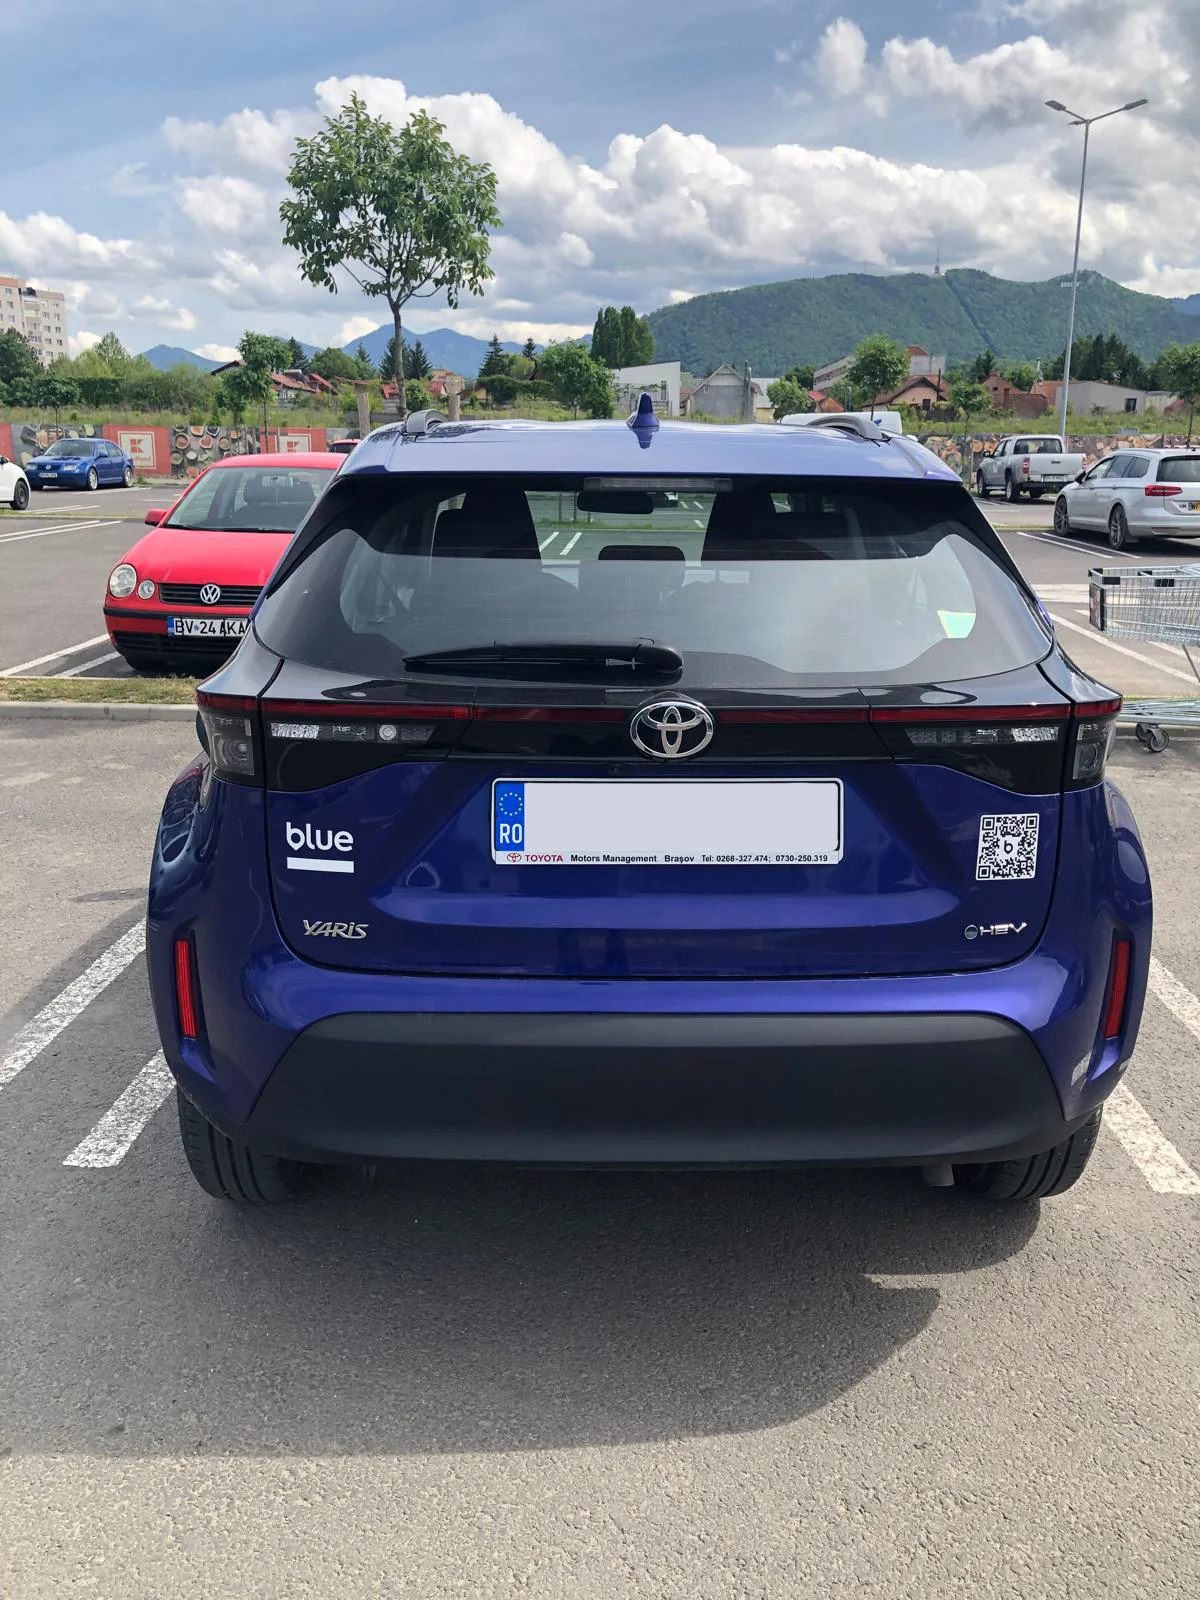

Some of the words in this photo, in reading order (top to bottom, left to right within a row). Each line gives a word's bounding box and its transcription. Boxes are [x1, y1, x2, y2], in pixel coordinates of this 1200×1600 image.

[175, 619, 194, 634] BV
[200, 621, 216, 635] 24
[220, 621, 246, 636] AKA
[286, 821, 354, 852] blue
[499, 823, 523, 844] RO
[525, 854, 563, 862] TOYOTA
[570, 854, 600, 863] Motors
[602, 855, 657, 863] Management
[701, 854, 714, 863] Tel:
[716, 855, 771, 863] 0268-327.474;
[775, 854, 828, 863] 0730-250.319
[979, 922, 1027, 936] HEV
